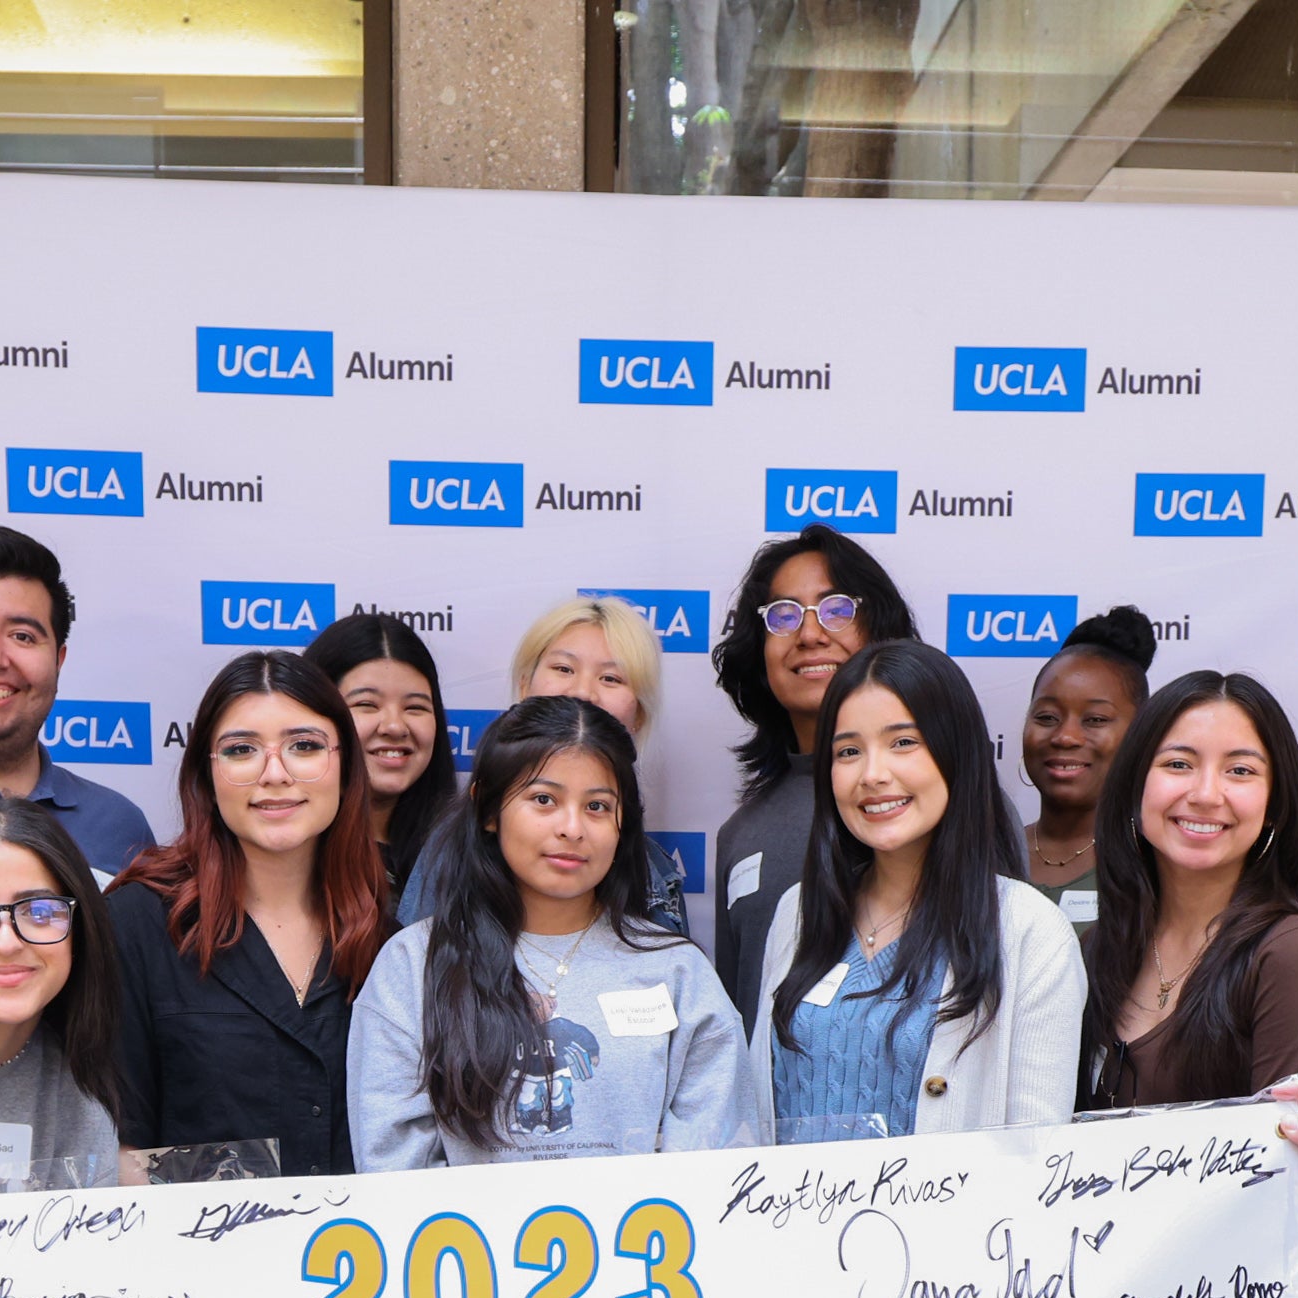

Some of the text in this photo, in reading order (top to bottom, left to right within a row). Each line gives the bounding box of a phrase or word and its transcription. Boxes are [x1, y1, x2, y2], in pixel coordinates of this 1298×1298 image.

[216, 344, 453, 382] UCLA Alumni
[600, 356, 831, 391] UCLA Alumni
[973, 363, 1202, 396] UCLA Alumni
[26, 465, 263, 503] UCLA Alumni
[408, 477, 641, 512] UCLA Alumni
[784, 485, 1013, 518] UCLA Alumni
[1153, 489, 1246, 521] UCLA
[221, 597, 318, 631] UCLA
[965, 610, 1059, 643] UCLA
[38, 716, 134, 749] UCLA
[526, 1144, 565, 1152] UNIVERSITY
